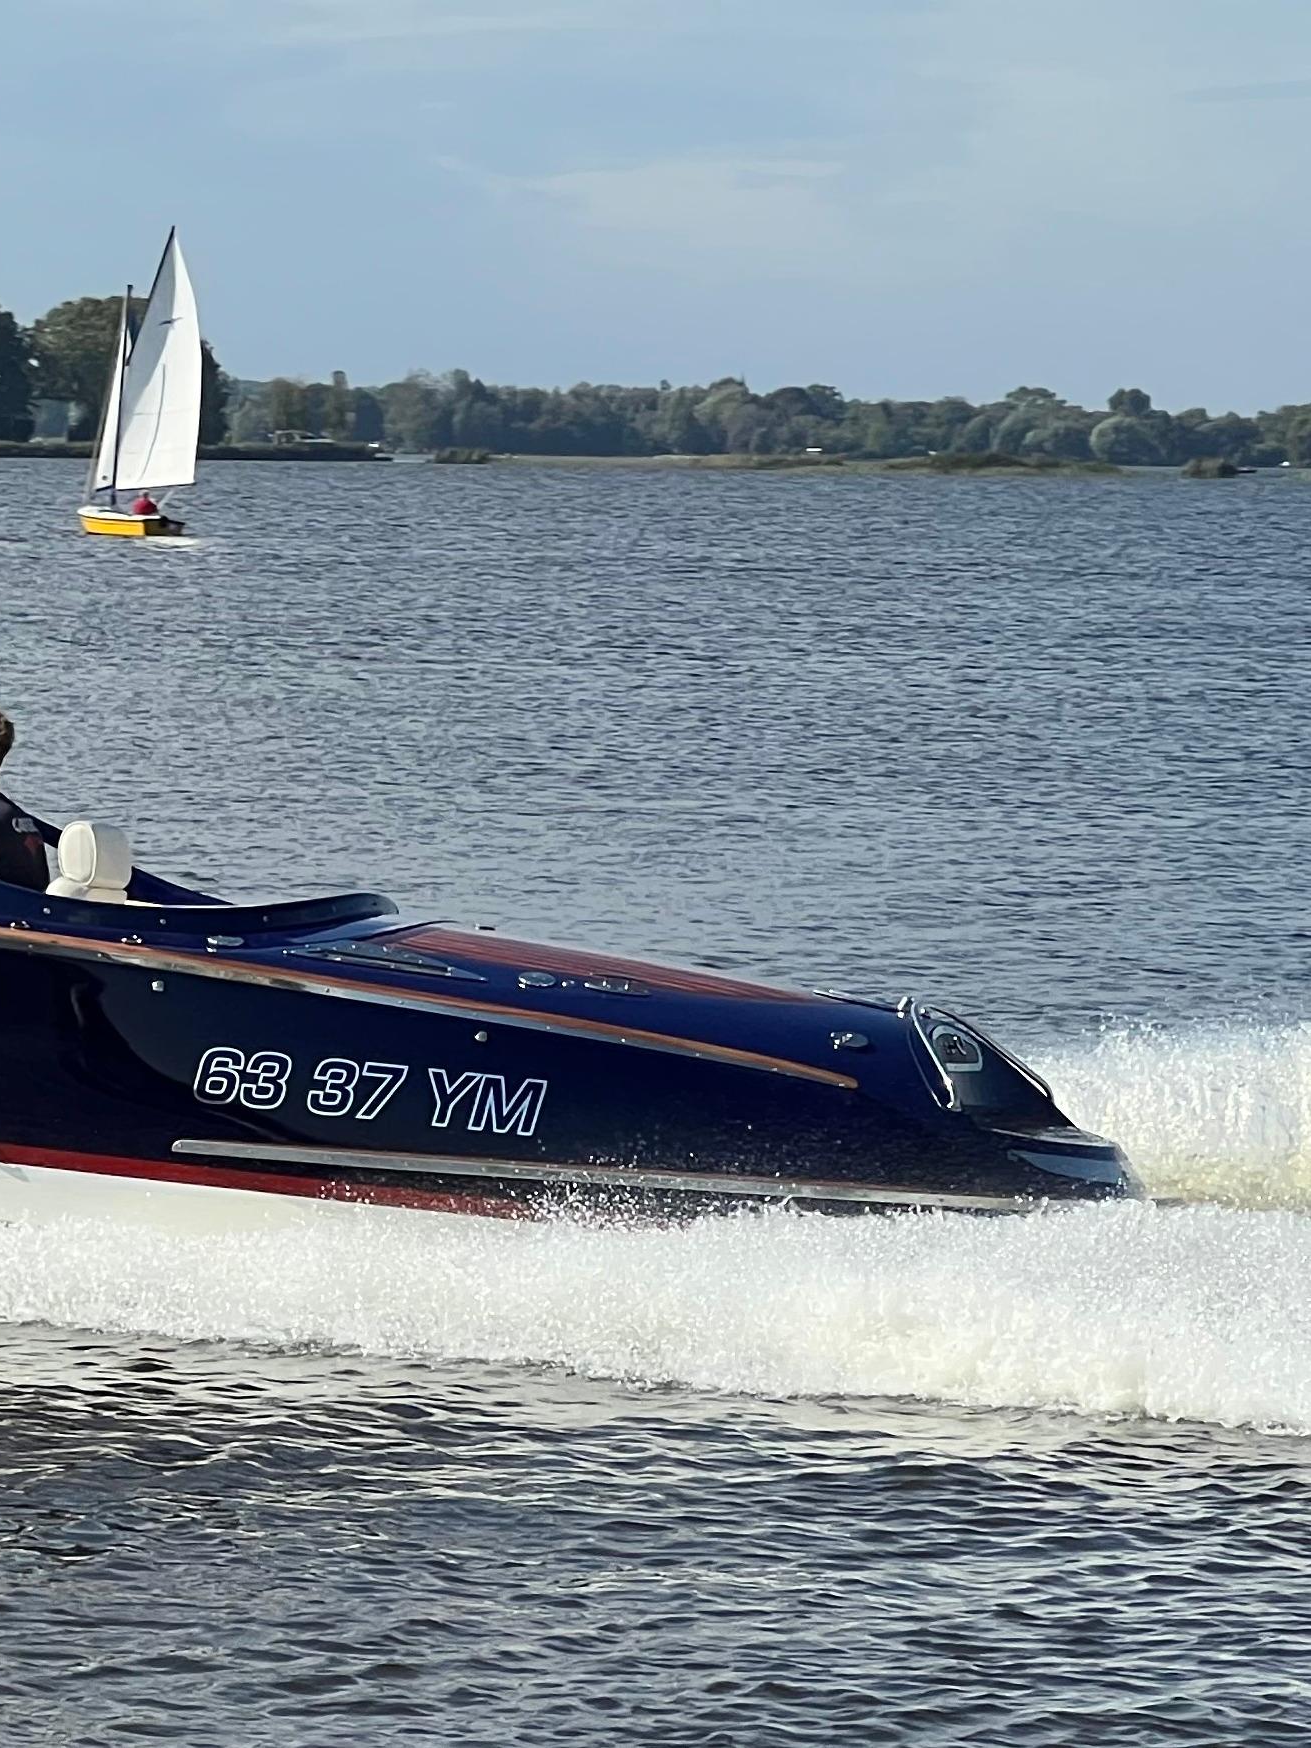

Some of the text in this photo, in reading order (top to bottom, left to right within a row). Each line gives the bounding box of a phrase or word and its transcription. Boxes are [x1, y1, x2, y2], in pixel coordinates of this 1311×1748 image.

[192, 1046, 548, 1137] 63 37 YM
